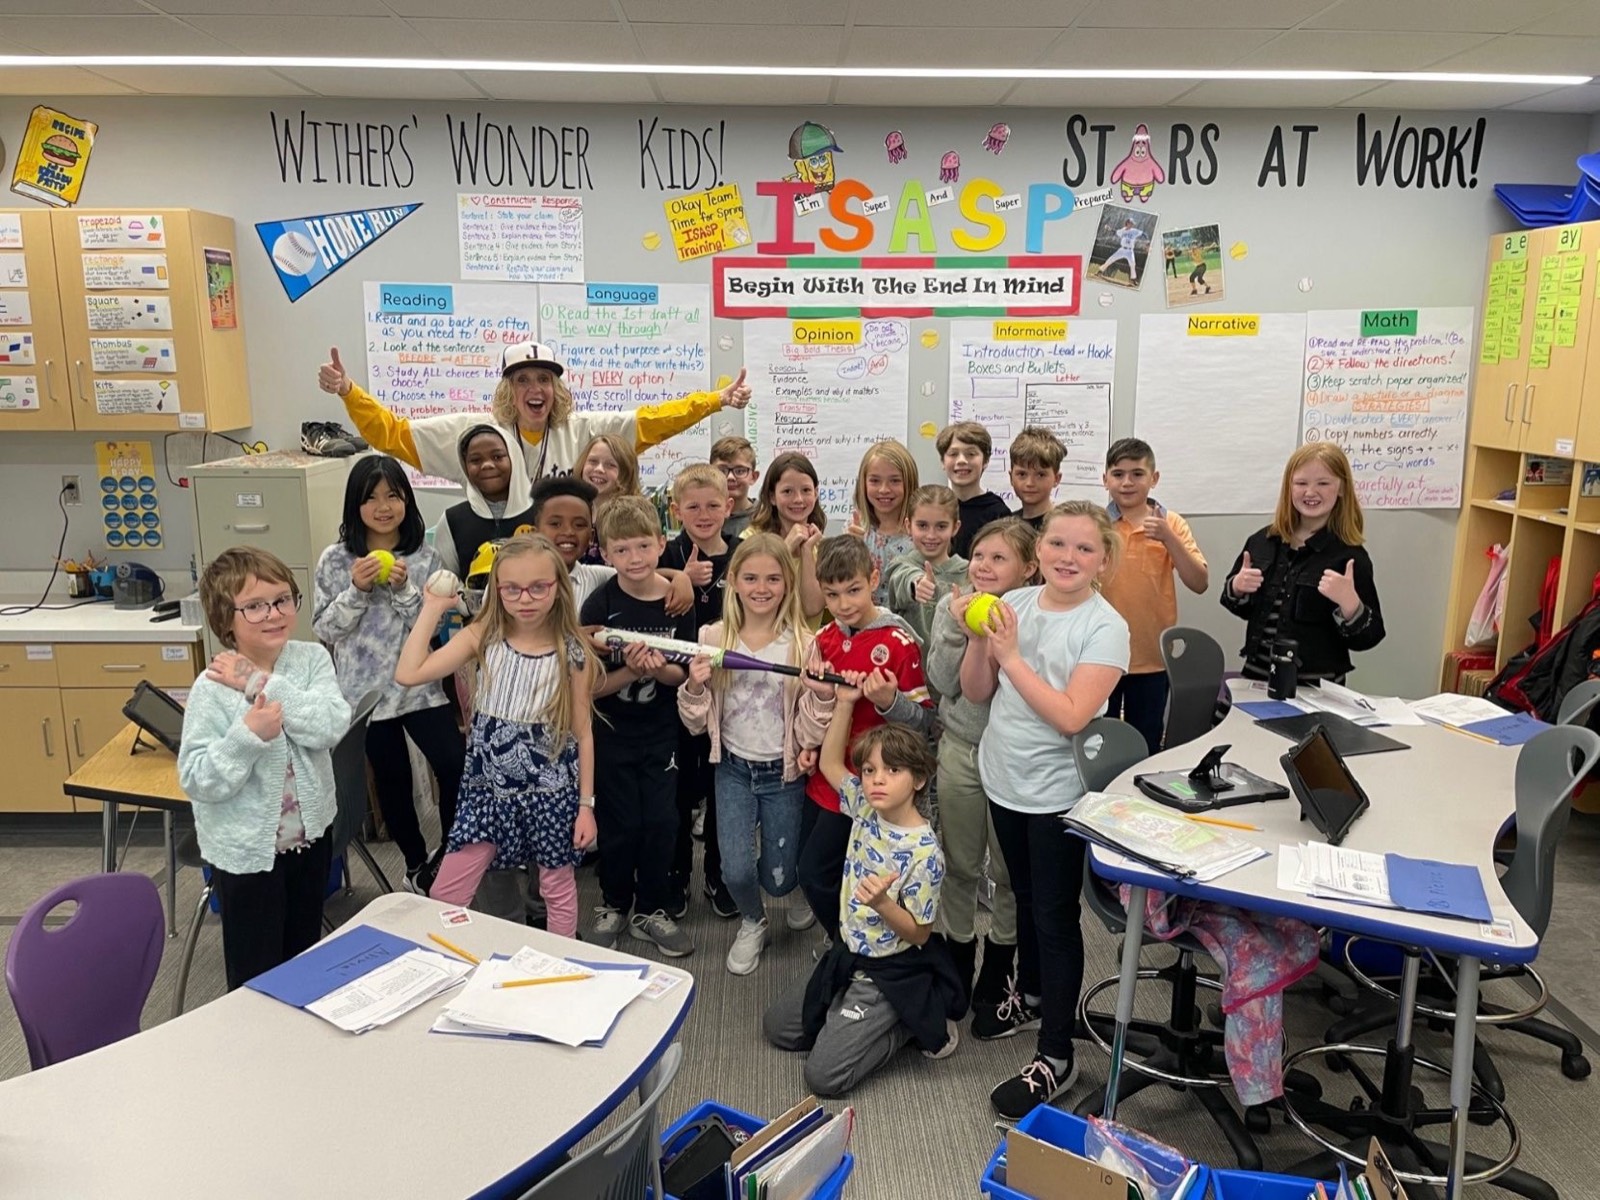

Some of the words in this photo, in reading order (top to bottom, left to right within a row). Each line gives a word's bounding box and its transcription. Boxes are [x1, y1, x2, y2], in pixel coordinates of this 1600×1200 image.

[51, 119, 86, 140] RECIPE
[270, 110, 418, 188] WITHERS'
[446, 112, 594, 190] WONDER
[638, 116, 725, 191] KIDS!
[1062, 113, 1220, 188] STRS
[1257, 124, 1320, 188] AT
[1356, 112, 1487, 190] WORK!
[671, 199, 702, 215] Okay
[703, 184, 738, 206] Team!
[797, 198, 820, 213] I'm
[863, 199, 888, 213] Super
[929, 190, 949, 203] And
[995, 197, 1020, 210] Super
[1073, 187, 1113, 209] Prepared!
[79, 216, 122, 229] trapezoid
[670, 218, 697, 232] Time
[700, 211, 714, 222] for
[304, 212, 373, 271] HOME
[367, 207, 404, 236] RUN
[681, 222, 719, 244] ISASP
[1560, 229, 1578, 248] ay
[677, 229, 728, 259] Training!
[728, 276, 795, 296] Begin
[802, 276, 864, 295] With
[872, 276, 917, 295] The
[923, 276, 968, 294] End
[972, 276, 997, 294] In
[1003, 276, 1065, 294] Mind
[87, 297, 119, 308] square
[383, 292, 447, 310] Reading
[586, 287, 657, 303] Language
[557, 305, 590, 320] Read
[595, 307, 617, 320] the
[623, 308, 643, 320] 1st
[649, 306, 681, 320] draft
[684, 308, 700, 322] all
[1363, 313, 1410, 328] Math
[407, 316, 427, 327] and
[430, 319, 444, 332] go
[448, 317, 475, 328] back
[479, 319, 493, 328] as
[497, 316, 530, 331] often
[558, 321, 578, 336] the
[587, 322, 612, 336] way
[995, 326, 1066, 337] Informative
[1187, 316, 1258, 332] Narrative
[382, 328, 395, 337] as
[401, 328, 423, 341] you
[427, 328, 454, 339] need
[482, 329, 497, 341] GO
[795, 327, 854, 343] Opinion
[91, 339, 132, 349] rhombus
[383, 341, 407, 352] Look
[411, 341, 423, 352] at
[426, 342, 440, 352] the
[443, 343, 485, 353] sentences
[1339, 338, 1354, 347] and
[399, 352, 436, 363] BEFORE
[526, 344, 538, 359] J
[560, 343, 595, 357] Figure
[599, 343, 620, 356] out
[622, 347, 660, 358] purpose
[962, 343, 1044, 359] Introduction
[1087, 343, 1113, 359] Hook
[589, 358, 604, 368] did
[608, 358, 621, 368] the
[624, 358, 651, 369] author
[655, 359, 677, 369] write
[768, 362, 797, 372] Reason
[1338, 358, 1370, 369] Follow
[1374, 357, 1390, 368] the
[1393, 350, 1456, 368] directions!
[386, 366, 418, 379] Study
[423, 367, 441, 377] ALL
[445, 368, 480, 378] choices
[967, 360, 1002, 374] Boxes
[1004, 361, 1025, 375] and
[1027, 360, 1066, 375] Bullets
[95, 380, 114, 389] kite
[391, 378, 429, 390] choose!
[566, 369, 584, 388] Try
[592, 370, 624, 385] EVERY
[772, 375, 808, 384] Evidence
[1056, 374, 1081, 382] Letter
[1322, 374, 1345, 390] Keep
[1349, 374, 1382, 385] scratch
[1386, 377, 1413, 389] paper
[392, 389, 427, 401] Choose
[430, 390, 445, 400] the
[448, 388, 475, 401] BEST
[604, 389, 632, 401] scroll
[634, 389, 660, 401] down
[661, 389, 673, 401] to
[775, 386, 812, 398] Examples
[815, 387, 830, 395] and
[853, 386, 880, 395] matters
[411, 404, 445, 417] problem
[775, 412, 803, 423] Reason
[1391, 414, 1420, 427] EVERY
[776, 426, 816, 434] Evidence
[1324, 428, 1349, 443] Copy
[1353, 429, 1394, 439] numbers
[775, 437, 814, 449] Examples
[816, 436, 831, 445] and
[835, 436, 850, 447] why
[1361, 443, 1382, 455] the
[1386, 445, 1414, 461] signs
[1351, 458, 1370, 471] for
[1406, 457, 1436, 468] words
[832, 476, 849, 488] why
[1407, 474, 1425, 490] at
[840, 1008, 861, 1020] PUMA
[1100, 1170, 1113, 1186] 10
